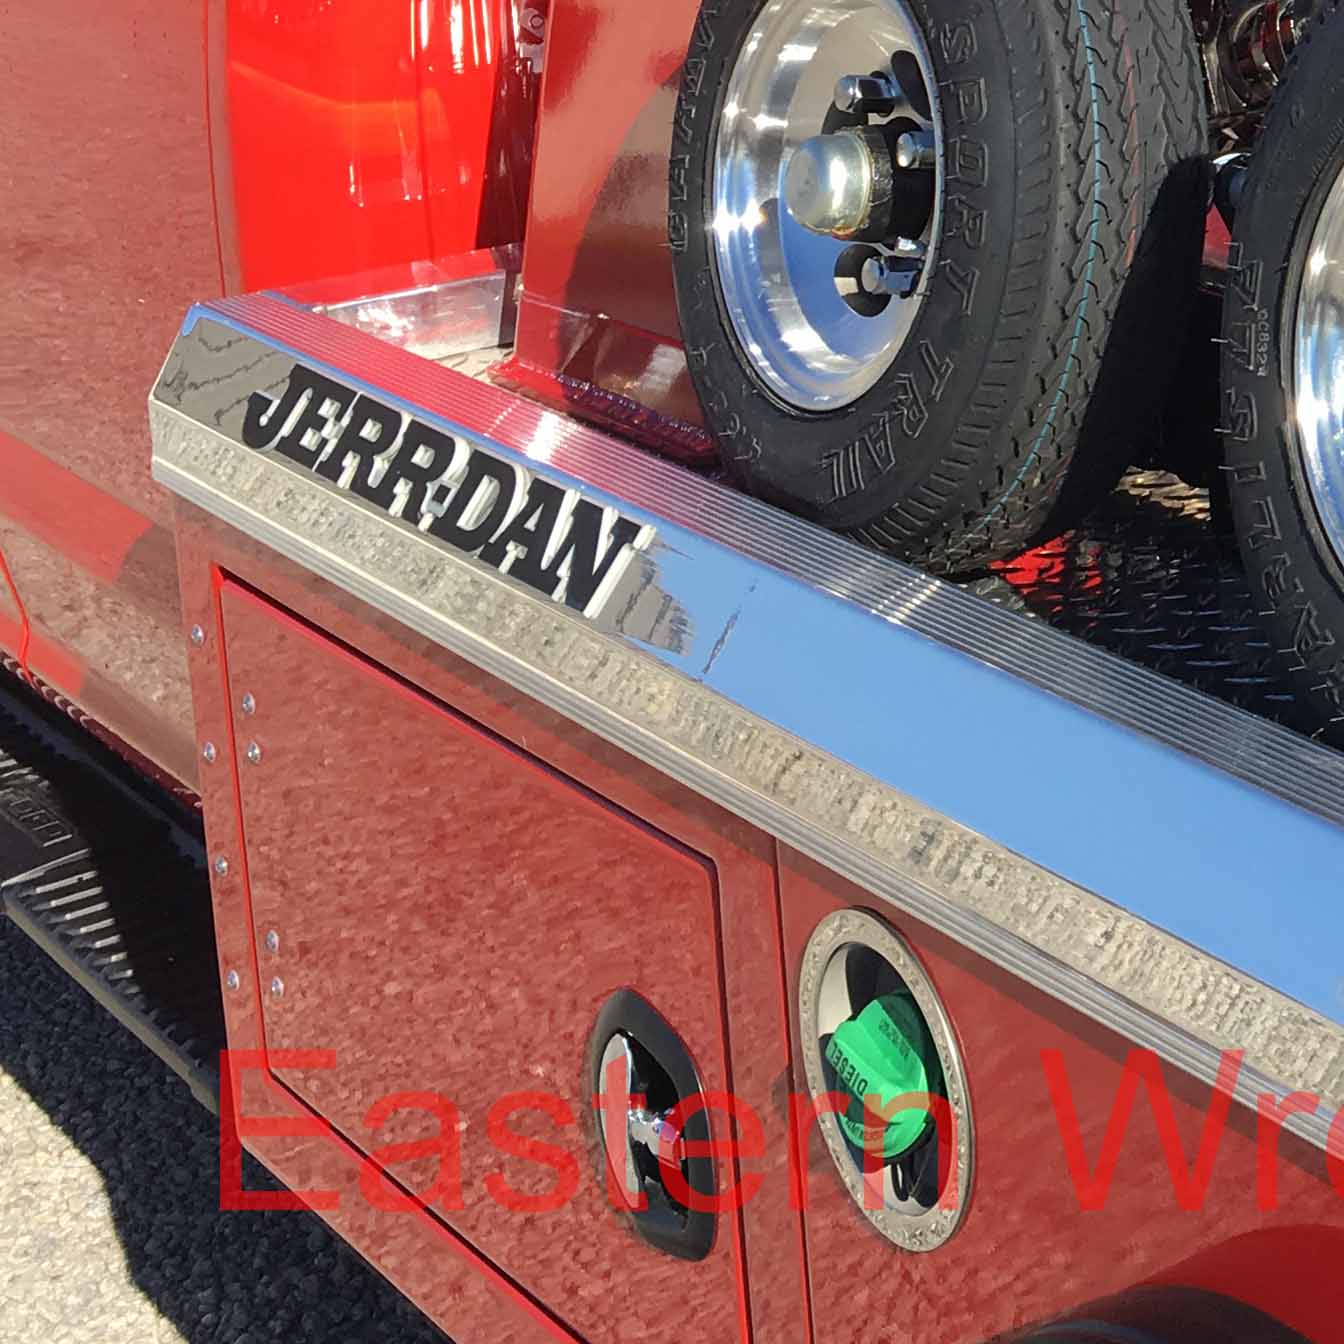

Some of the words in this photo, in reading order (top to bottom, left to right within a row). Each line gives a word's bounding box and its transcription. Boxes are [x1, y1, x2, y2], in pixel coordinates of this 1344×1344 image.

[940, 20, 988, 316] SPORT
[242, 362, 656, 619] JERR-DAN
[816, 339, 953, 505] TRAIL
[832, 1041, 868, 1097] DIESEL
